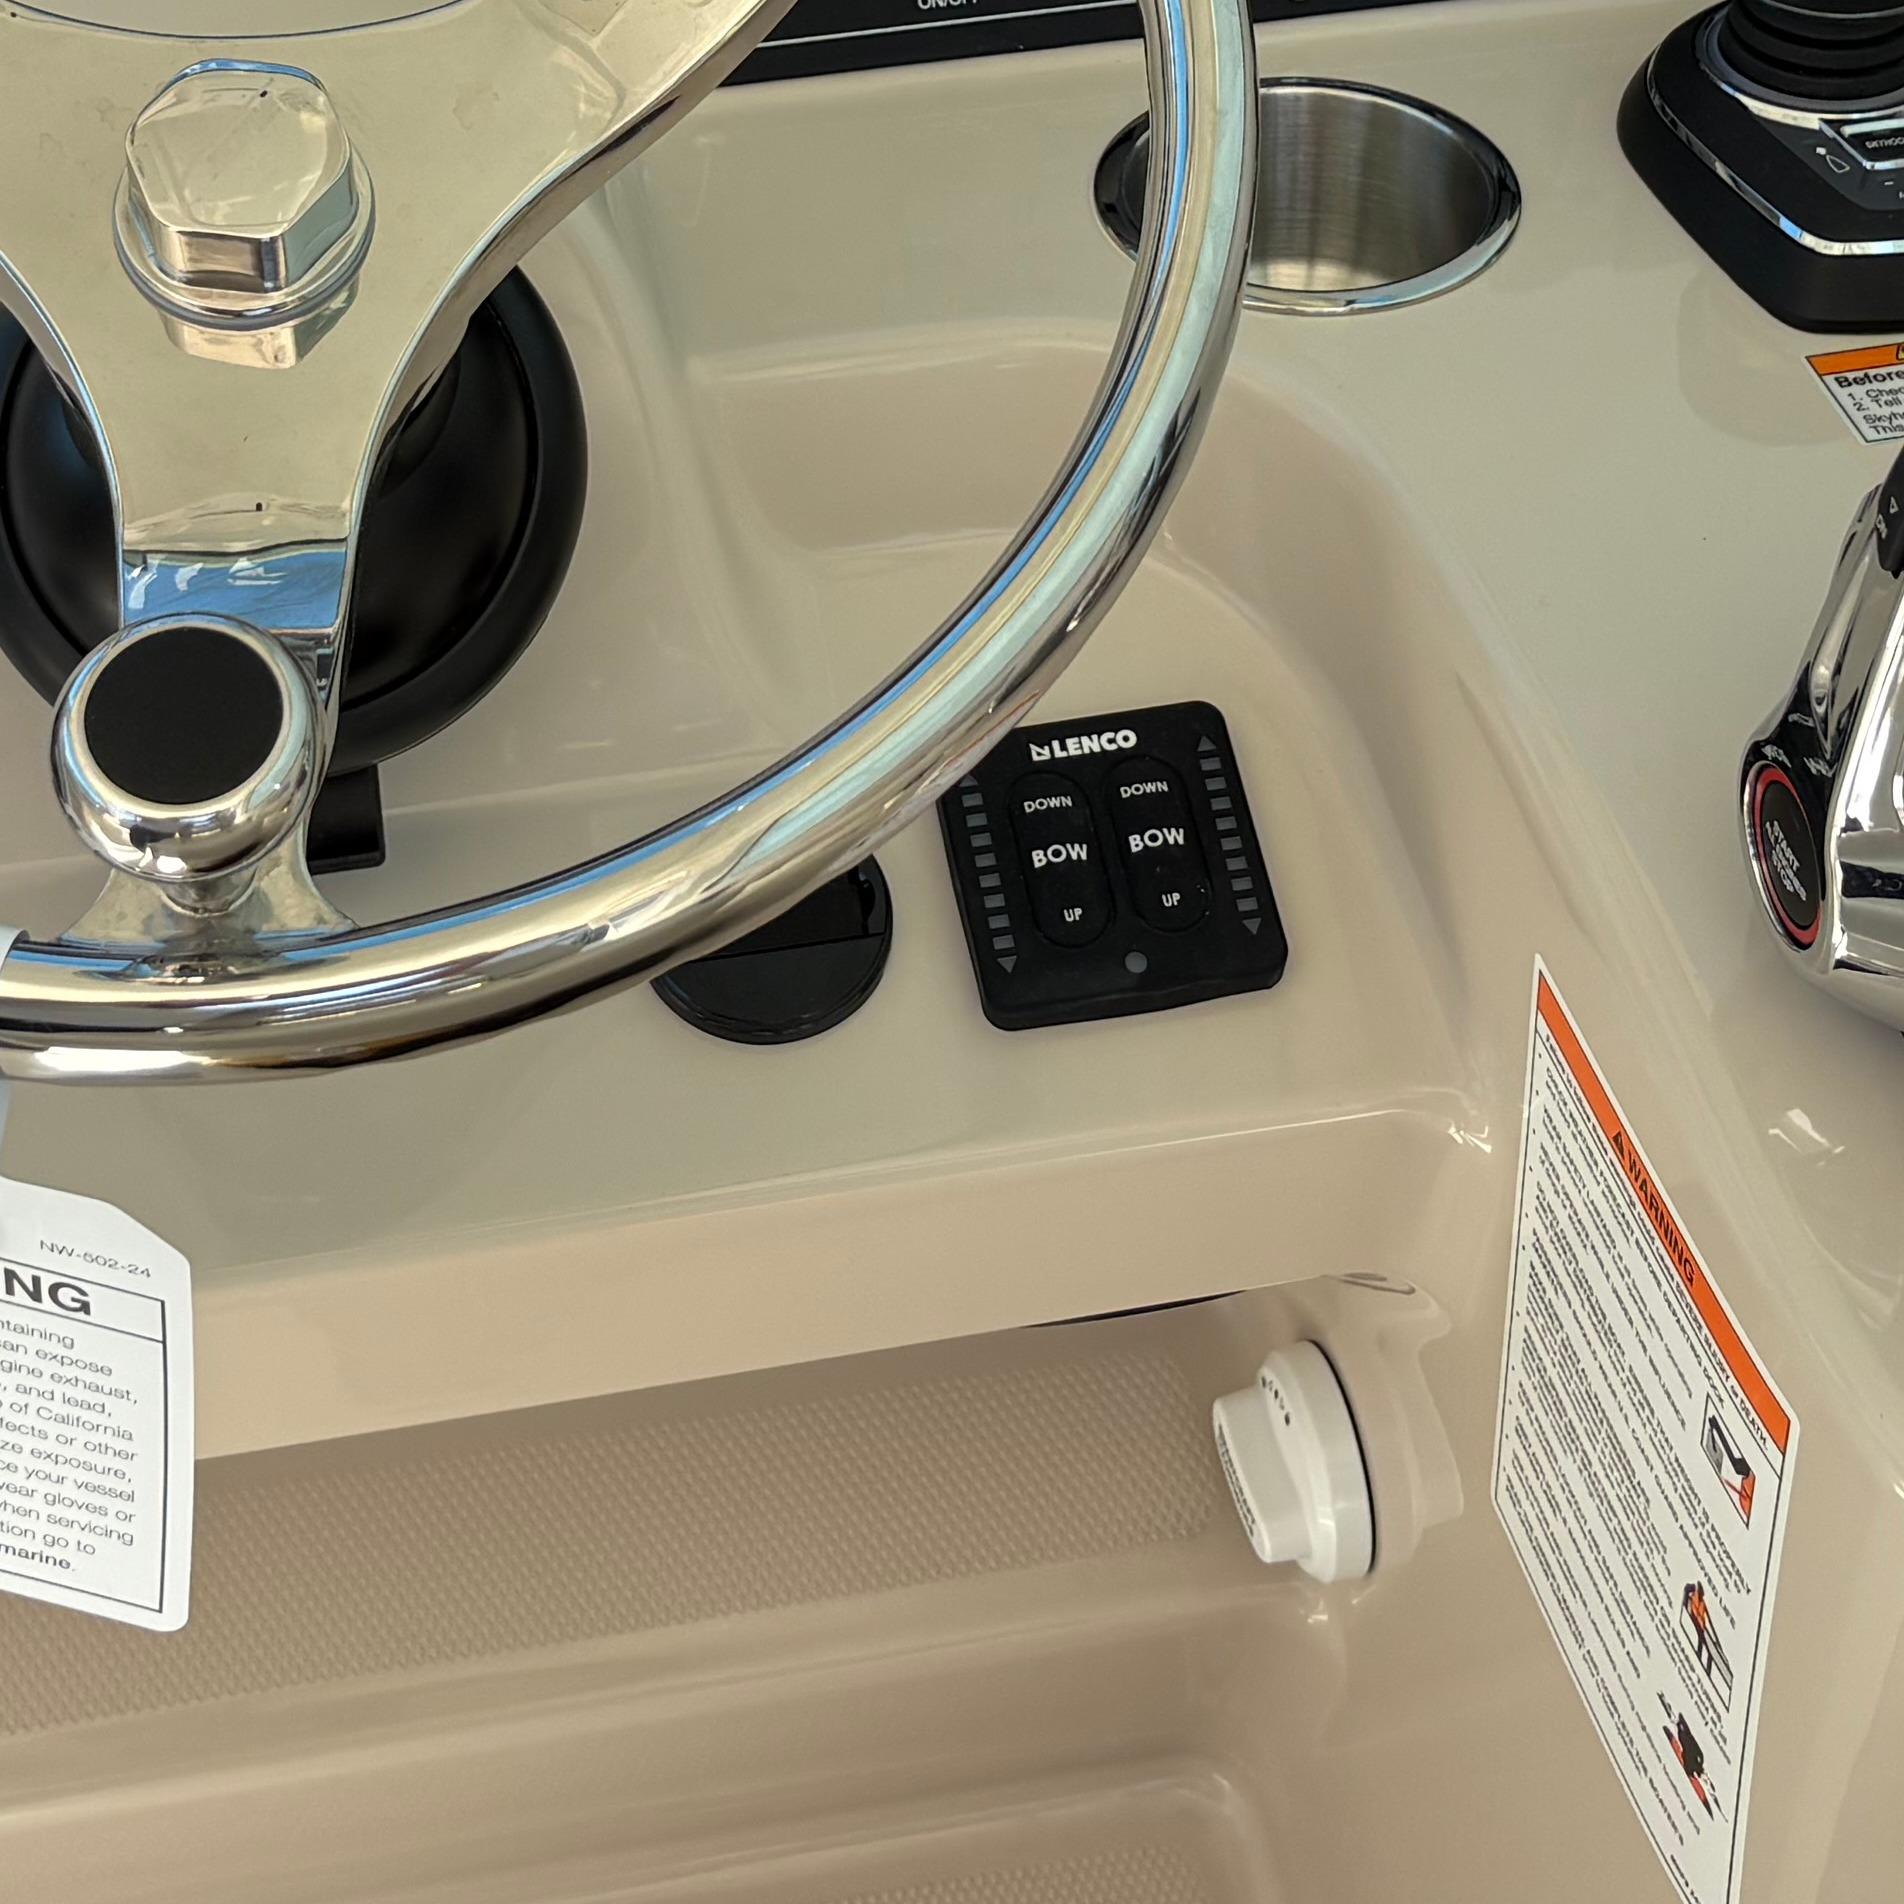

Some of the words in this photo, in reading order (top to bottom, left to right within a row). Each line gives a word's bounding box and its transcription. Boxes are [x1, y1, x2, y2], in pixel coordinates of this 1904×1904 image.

[1871, 396, 1903, 409] Tell
[1051, 729, 1137, 758] LENCO
[1023, 795, 1073, 813] DOWN
[1119, 780, 1169, 798] DOWN
[1031, 843, 1088, 869] BOW
[1128, 827, 1185, 853] BOW
[1063, 907, 1083, 923] UP
[1161, 892, 1181, 907] UP
[1625, 1149, 1696, 1287] WARNING
[35, 1347, 112, 1378] expose
[15, 1379, 54, 1401] and
[62, 1391, 111, 1417] lead,
[50, 1369, 137, 1405] exhaust,
[36, 1405, 134, 1441] California
[30, 1445, 131, 1483] exposure,
[83, 1437, 137, 1462] other
[24, 1465, 67, 1489] your
[73, 1475, 134, 1503] vessel
[43, 1488, 108, 1519] gloves
[46, 1510, 133, 1547] servicing
